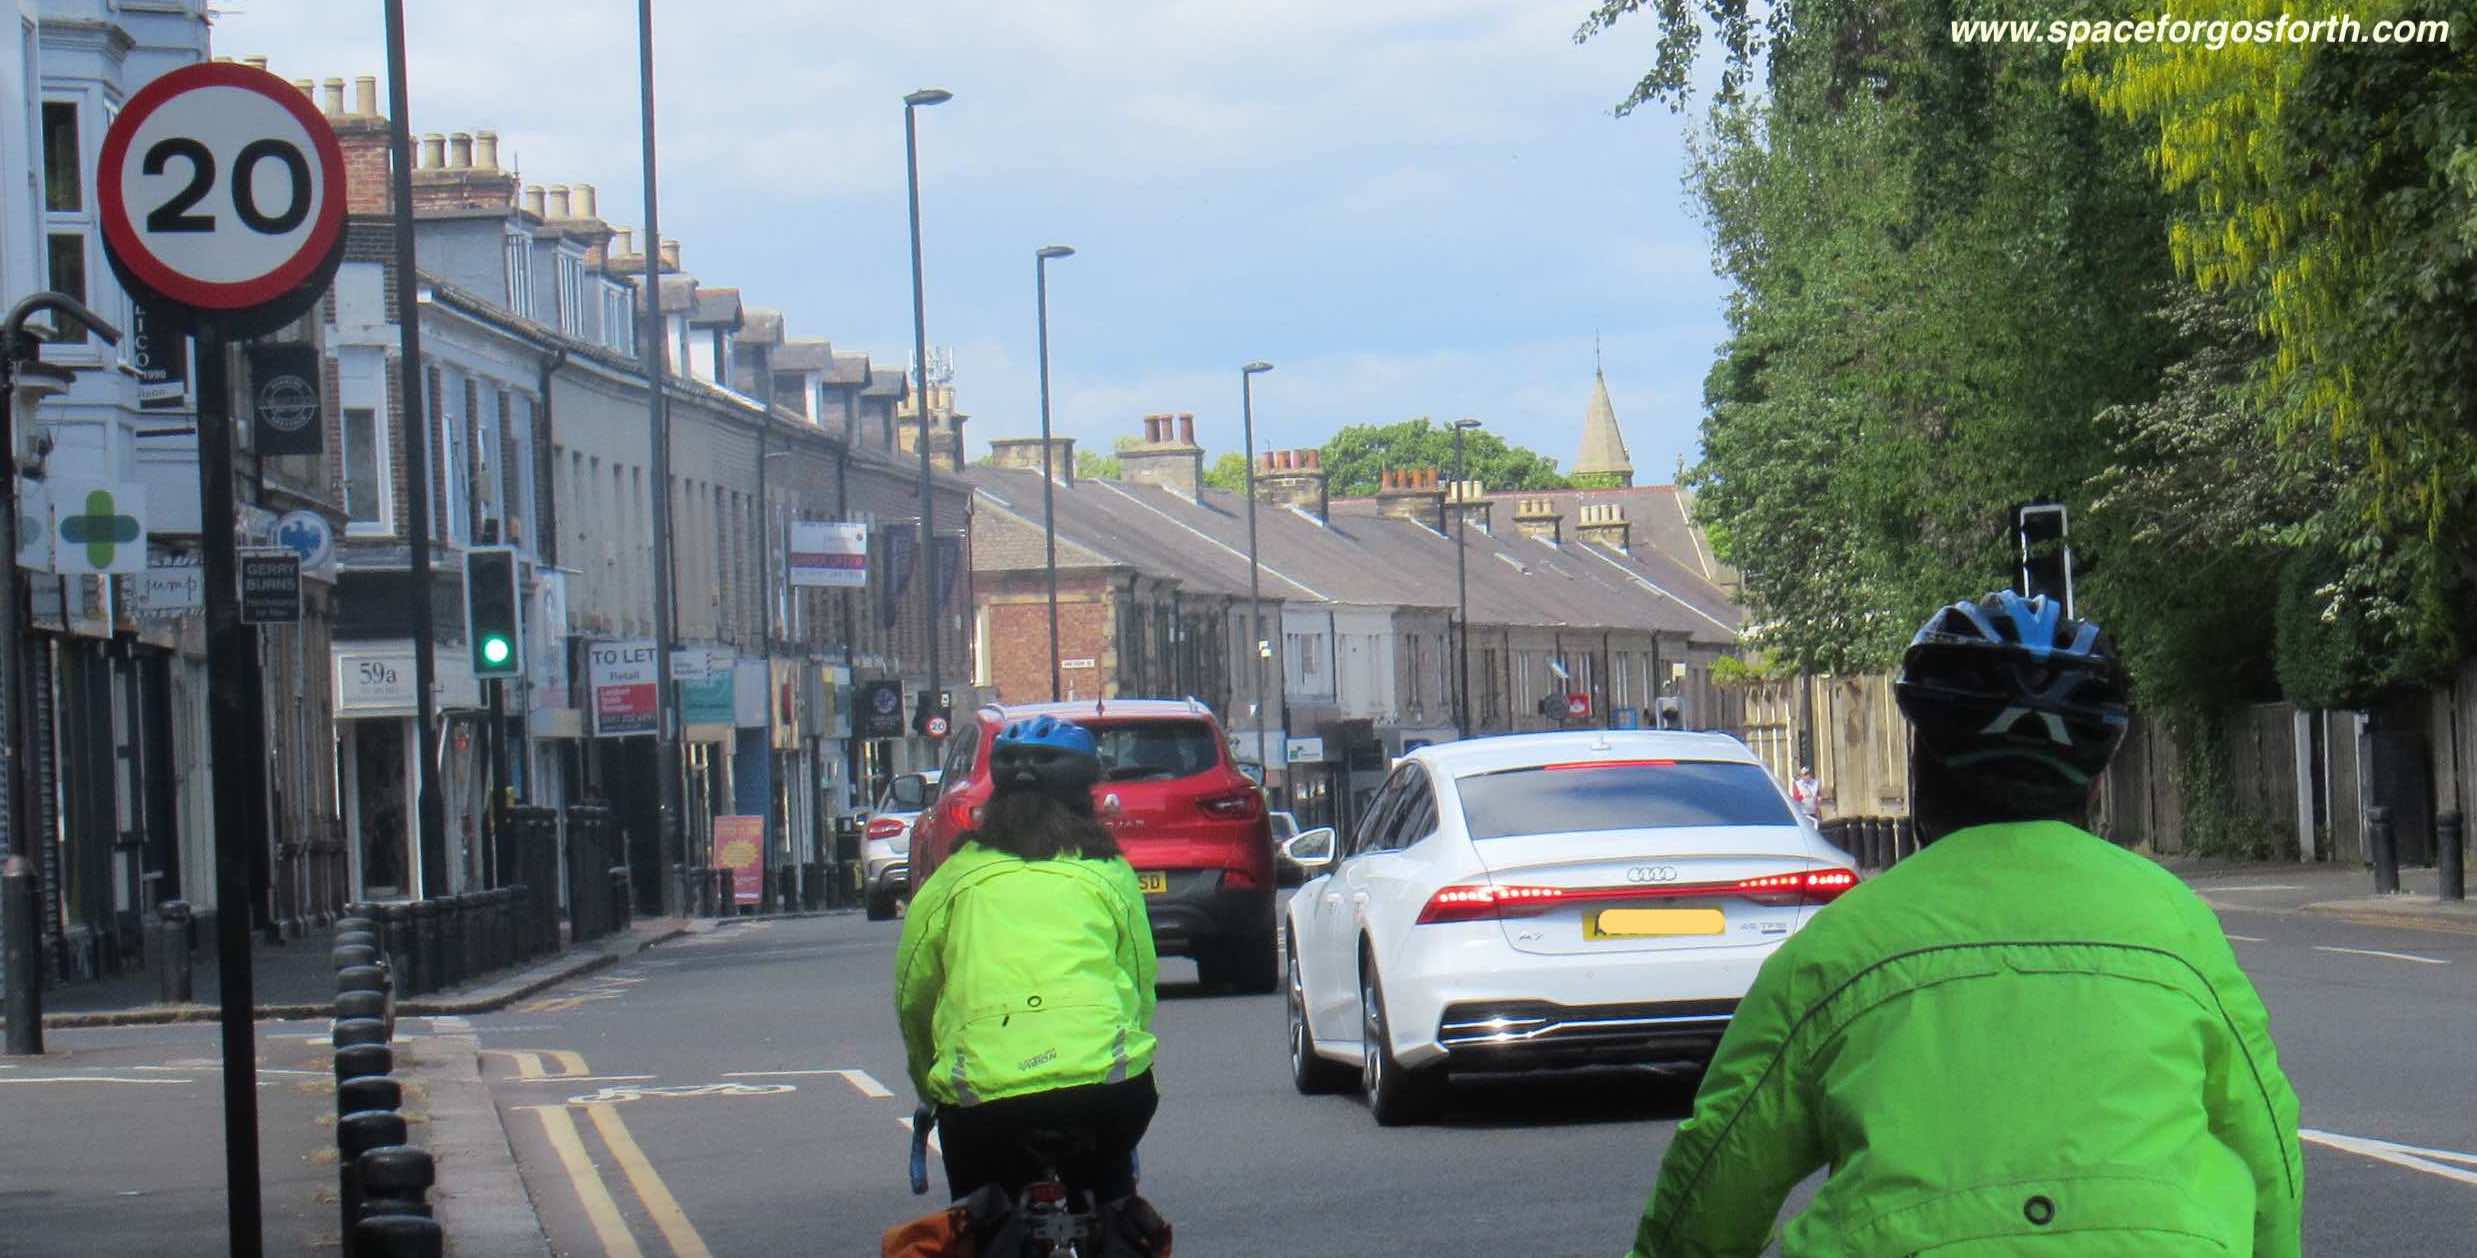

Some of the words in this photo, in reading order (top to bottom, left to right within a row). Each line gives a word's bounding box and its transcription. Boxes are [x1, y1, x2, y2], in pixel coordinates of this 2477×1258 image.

[142, 137, 312, 235] 20
[135, 303, 151, 368] LICO
[246, 563, 296, 576] GERRY
[246, 577, 296, 592] BURNS
[591, 649, 617, 665] TO
[623, 647, 656, 664] LET
[360, 661, 397, 684] 59a
[931, 721, 945, 731] 20
[1138, 874, 1160, 890] SD
